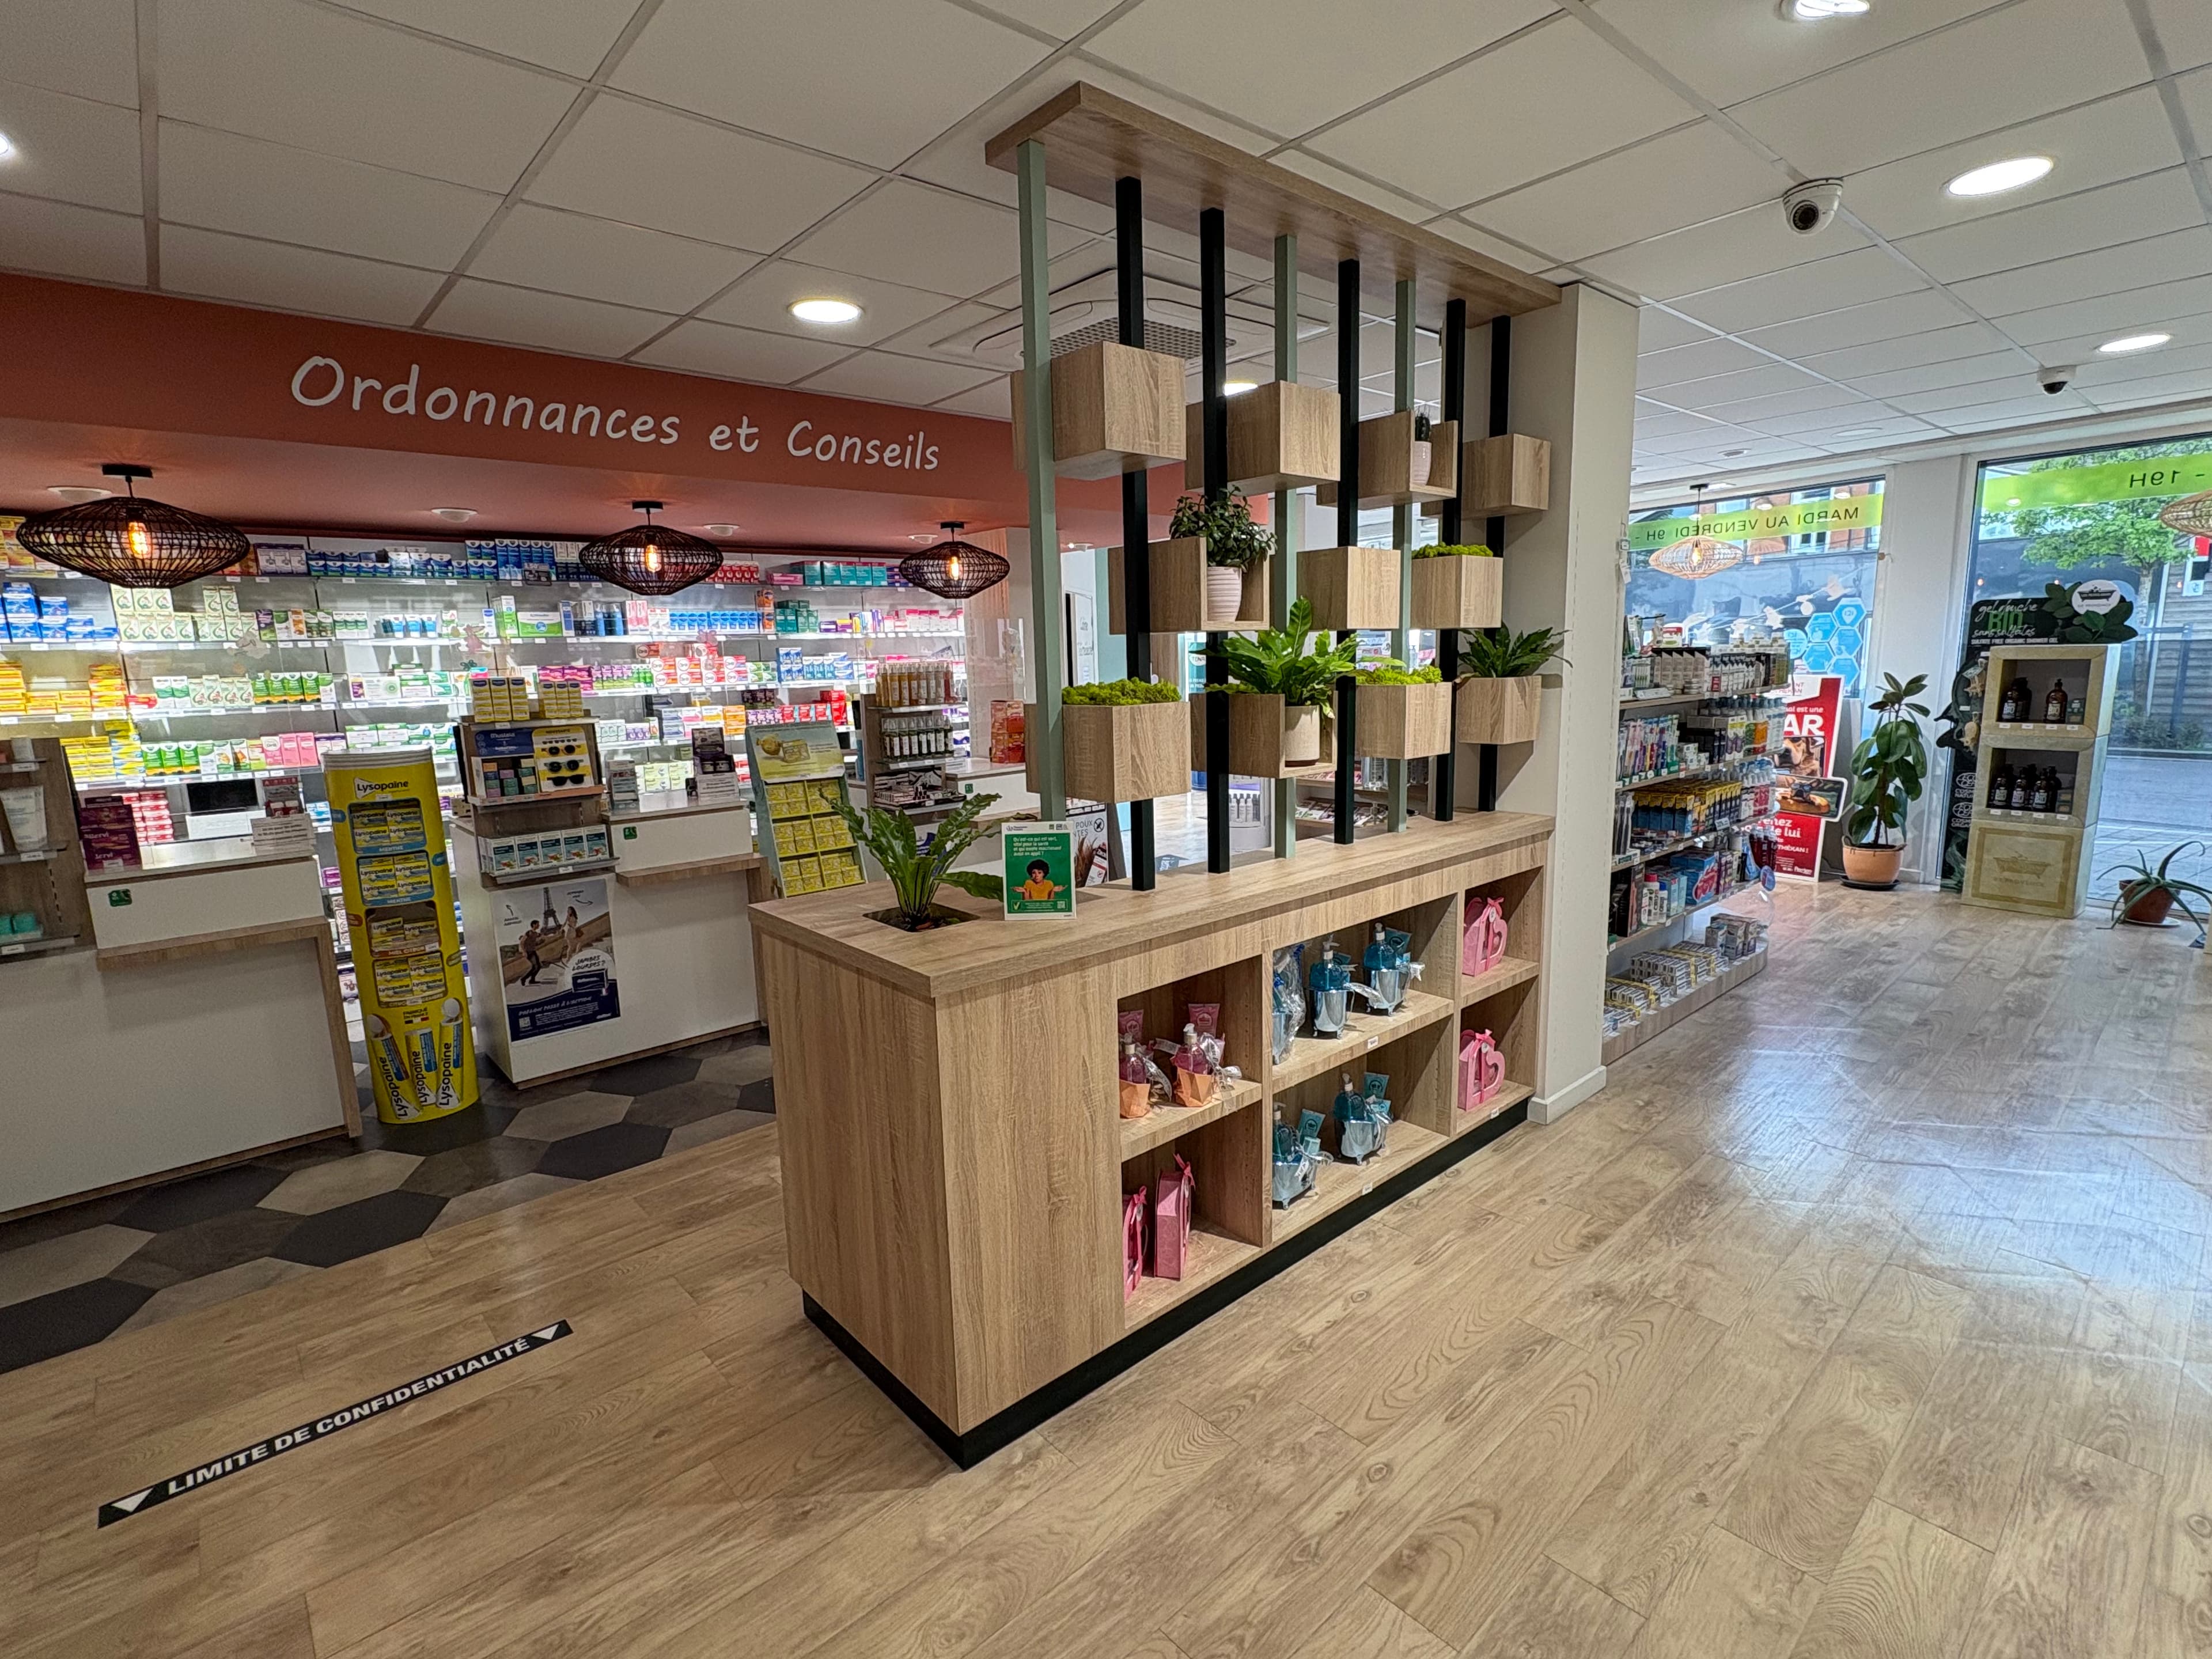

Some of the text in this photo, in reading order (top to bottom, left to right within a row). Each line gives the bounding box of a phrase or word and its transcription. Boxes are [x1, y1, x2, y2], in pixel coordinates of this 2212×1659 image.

[291, 355, 938, 470] Ordonnances et Conseils
[1975, 599, 2037, 622] gel douche
[1988, 611, 2023, 632] BIO
[1972, 628, 1995, 638] sans
[1075, 820, 1093, 829] POUX
[1785, 827, 1801, 838] lui
[168, 1338, 531, 1496] LIMITE DE CONFIDENTIALITÉ
